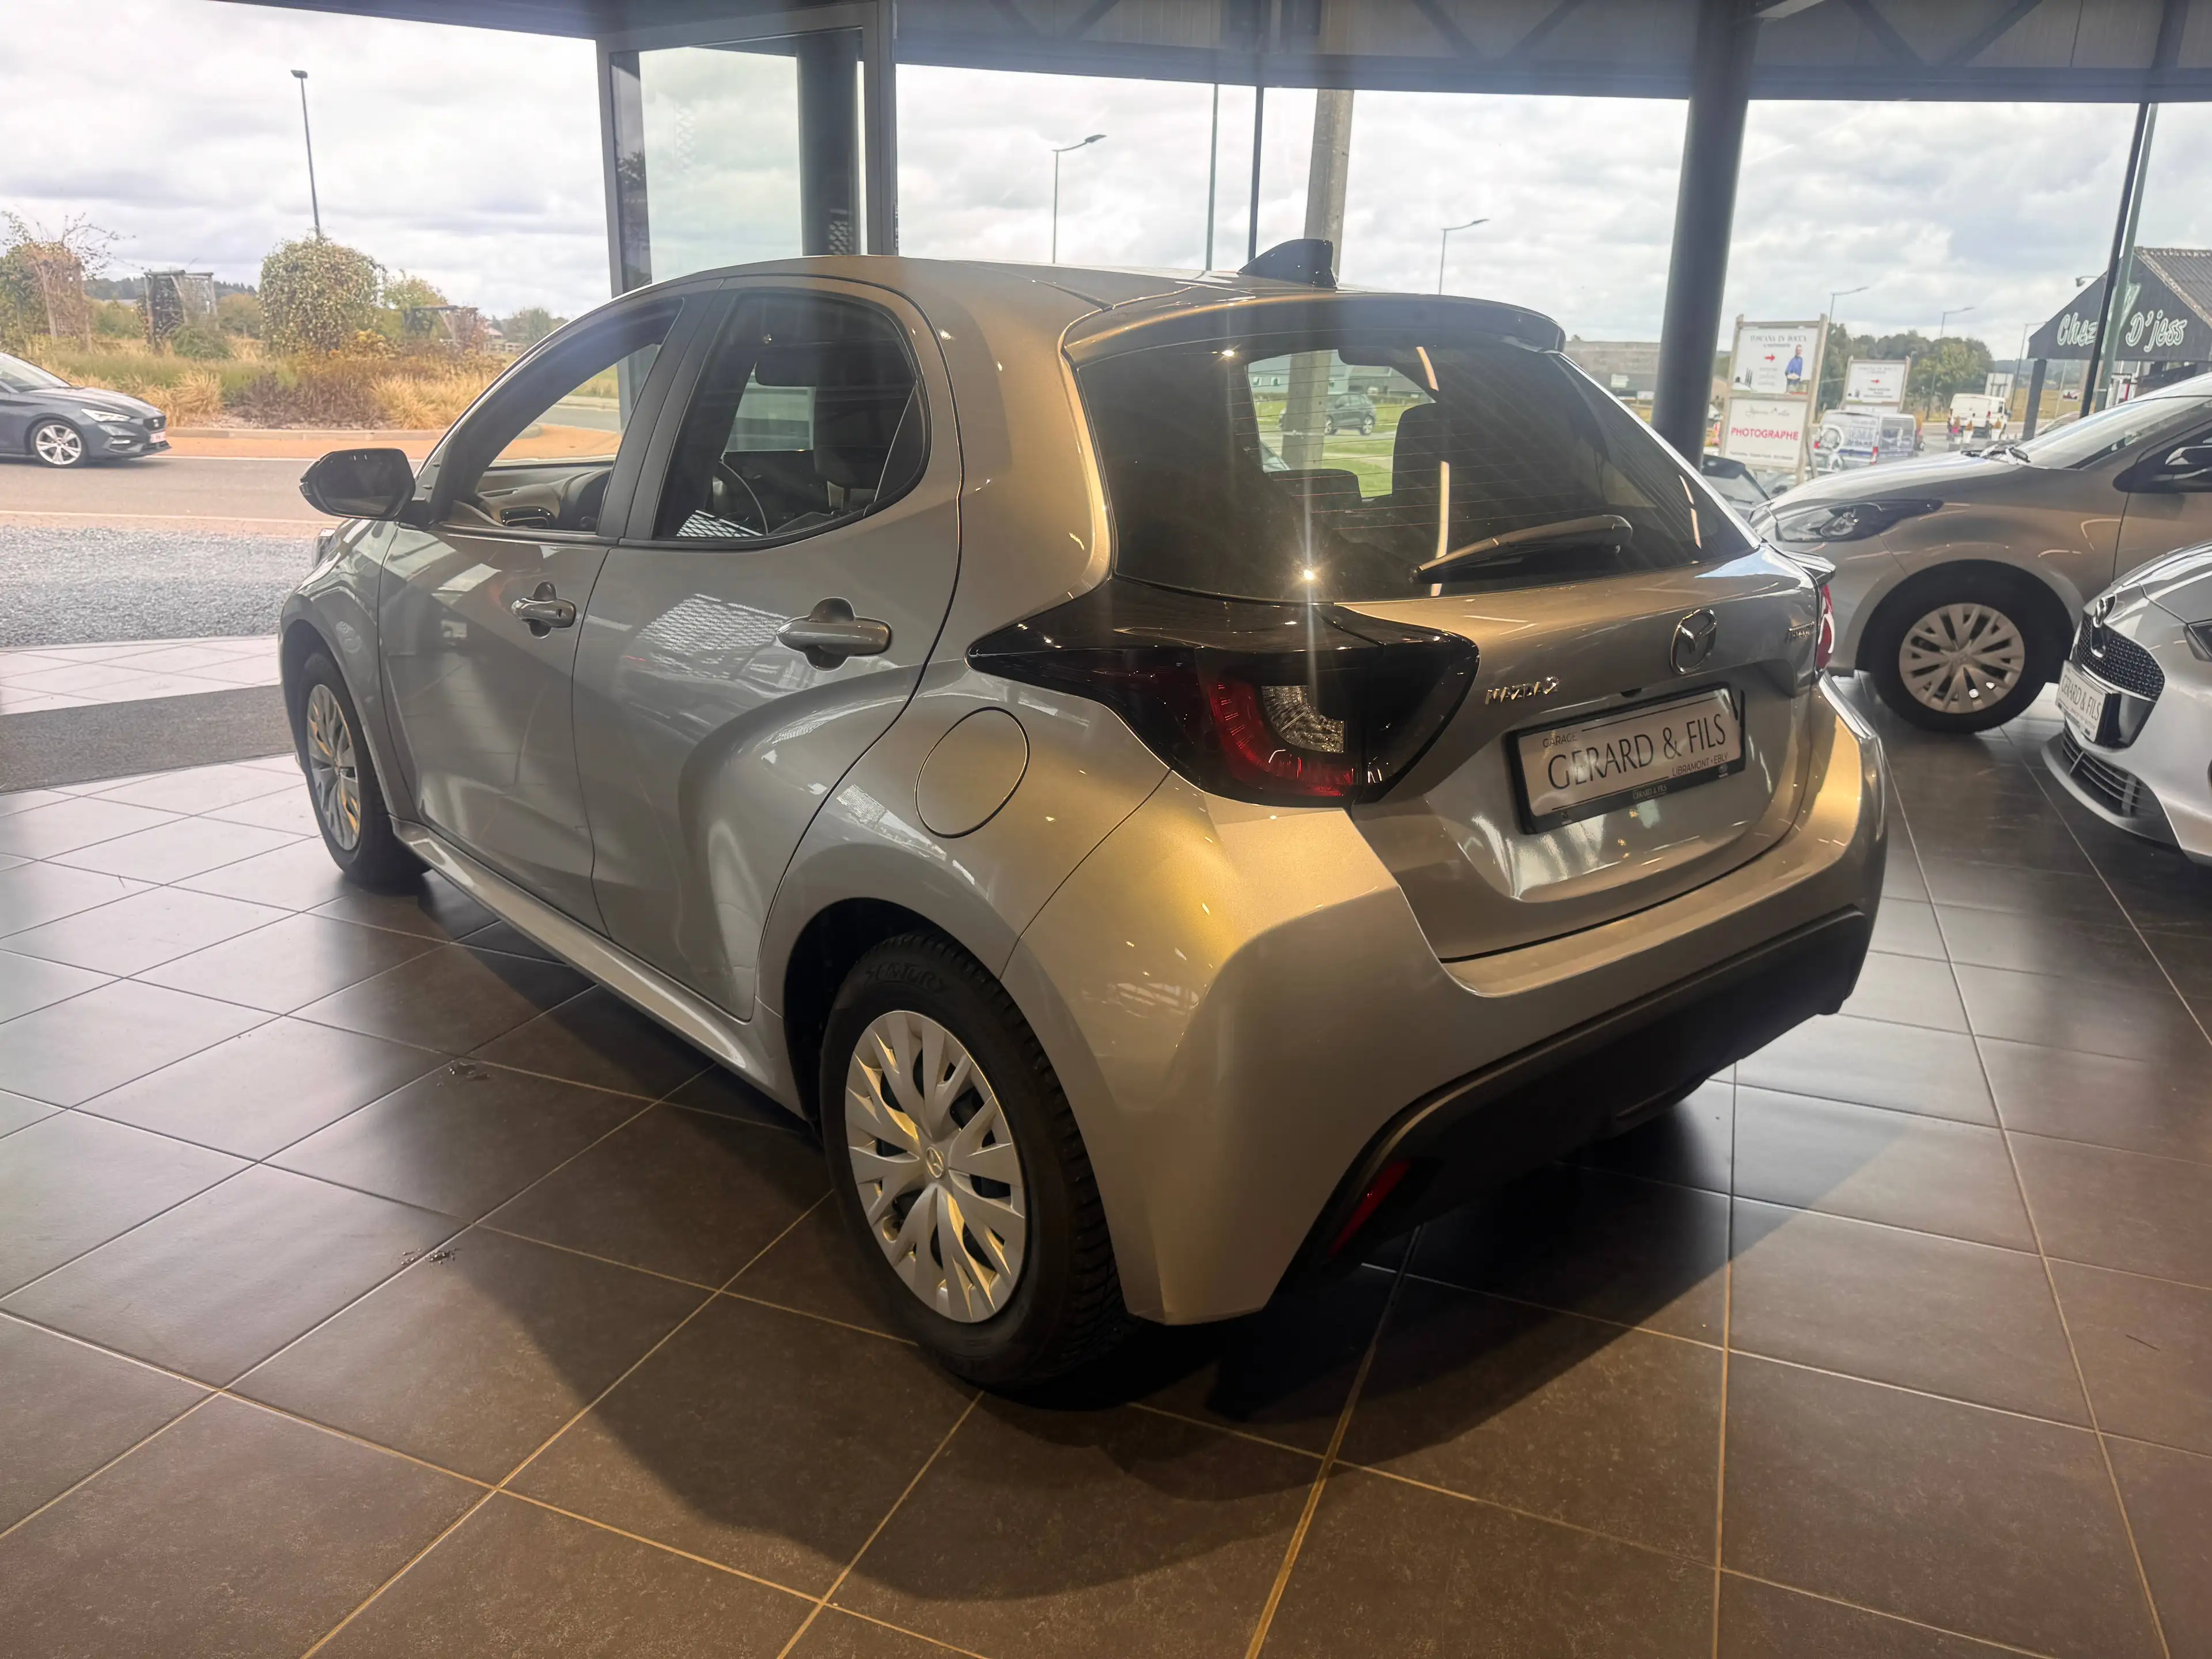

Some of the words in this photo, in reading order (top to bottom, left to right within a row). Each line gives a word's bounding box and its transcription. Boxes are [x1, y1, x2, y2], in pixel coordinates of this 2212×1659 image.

[2057, 312, 2099, 347] Chez
[2125, 309, 2188, 353] D'jess
[1730, 427, 1799, 441] PHOTOGRAPHE
[2086, 696, 2101, 721] FILS
[1543, 732, 1578, 748] GARAGE
[1548, 734, 1654, 790] GERARD
[1662, 727, 1682, 760] &
[1686, 713, 1726, 753] FILS
[1672, 757, 1710, 777] LIBRAMONT
[1714, 752, 1729, 764] EBLY
